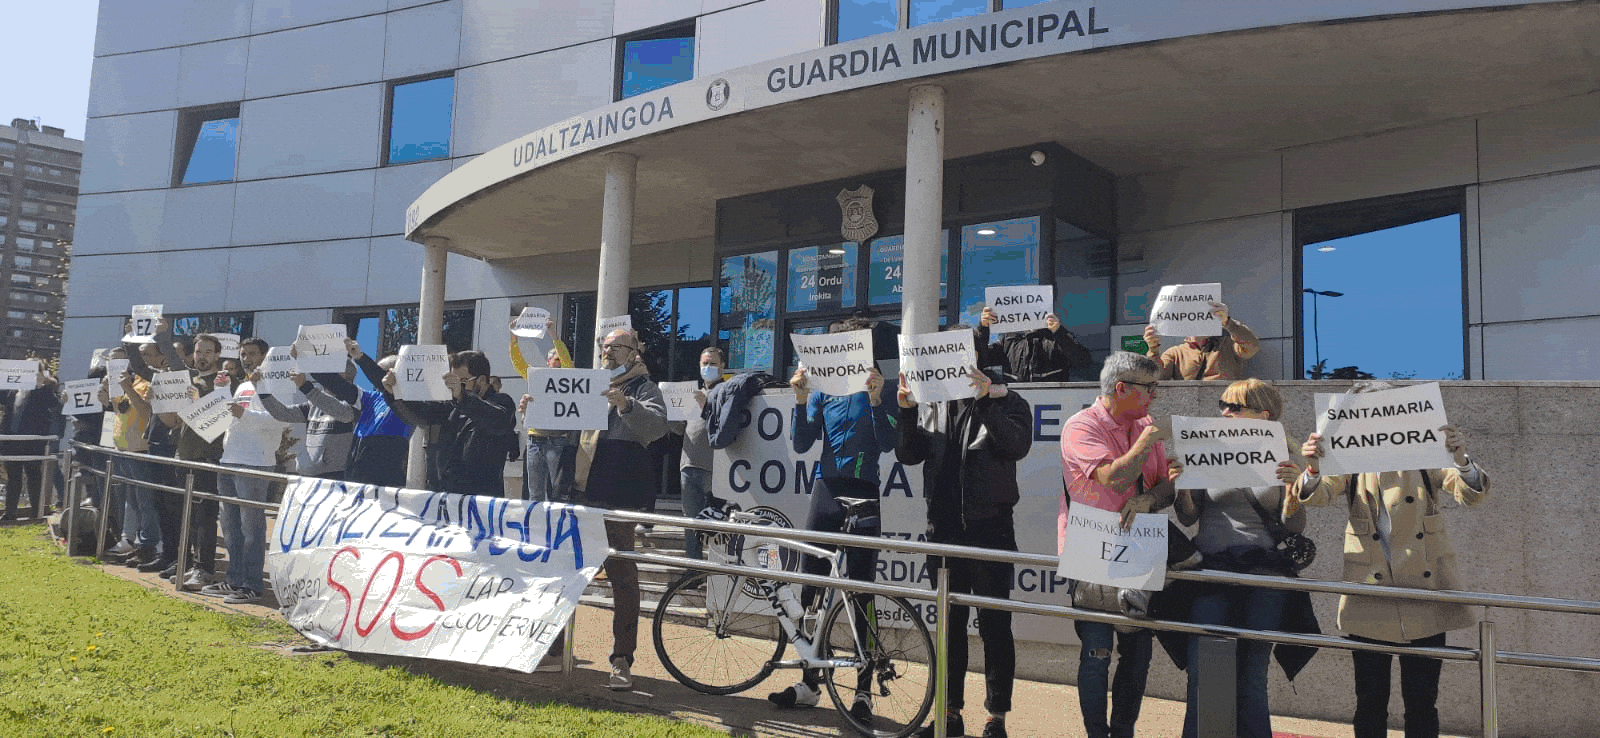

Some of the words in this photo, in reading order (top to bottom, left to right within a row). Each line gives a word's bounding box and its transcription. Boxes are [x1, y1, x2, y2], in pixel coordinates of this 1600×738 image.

[767, 43, 901, 93] GUARDIA
[912, 6, 1109, 65] MUNICIPAL
[512, 96, 674, 168] UDALTZAINGOA
[885, 265, 901, 280] 24
[800, 275, 817, 289] 24
[818, 276, 843, 287] Ordu
[995, 295, 1023, 306] ASKI
[1026, 294, 1043, 304] DA
[1157, 312, 1214, 321] KANPORA
[137, 319, 152, 335] EZ
[798, 342, 865, 355] SANTAMARIA
[7, 375, 21, 383] EZ
[407, 368, 425, 382] EZ
[905, 366, 967, 382] KANPORA
[545, 377, 591, 394] ASKI
[73, 391, 94, 408] EZ
[553, 401, 580, 418] DA
[1327, 400, 1434, 421] SANTAMARIA
[1180, 428, 1274, 440] SANTAMARIA
[1330, 428, 1438, 449] KANPORA
[1184, 450, 1277, 466] KANPORA
[1100, 541, 1129, 563] EZ
[327, 545, 463, 642] SOS
